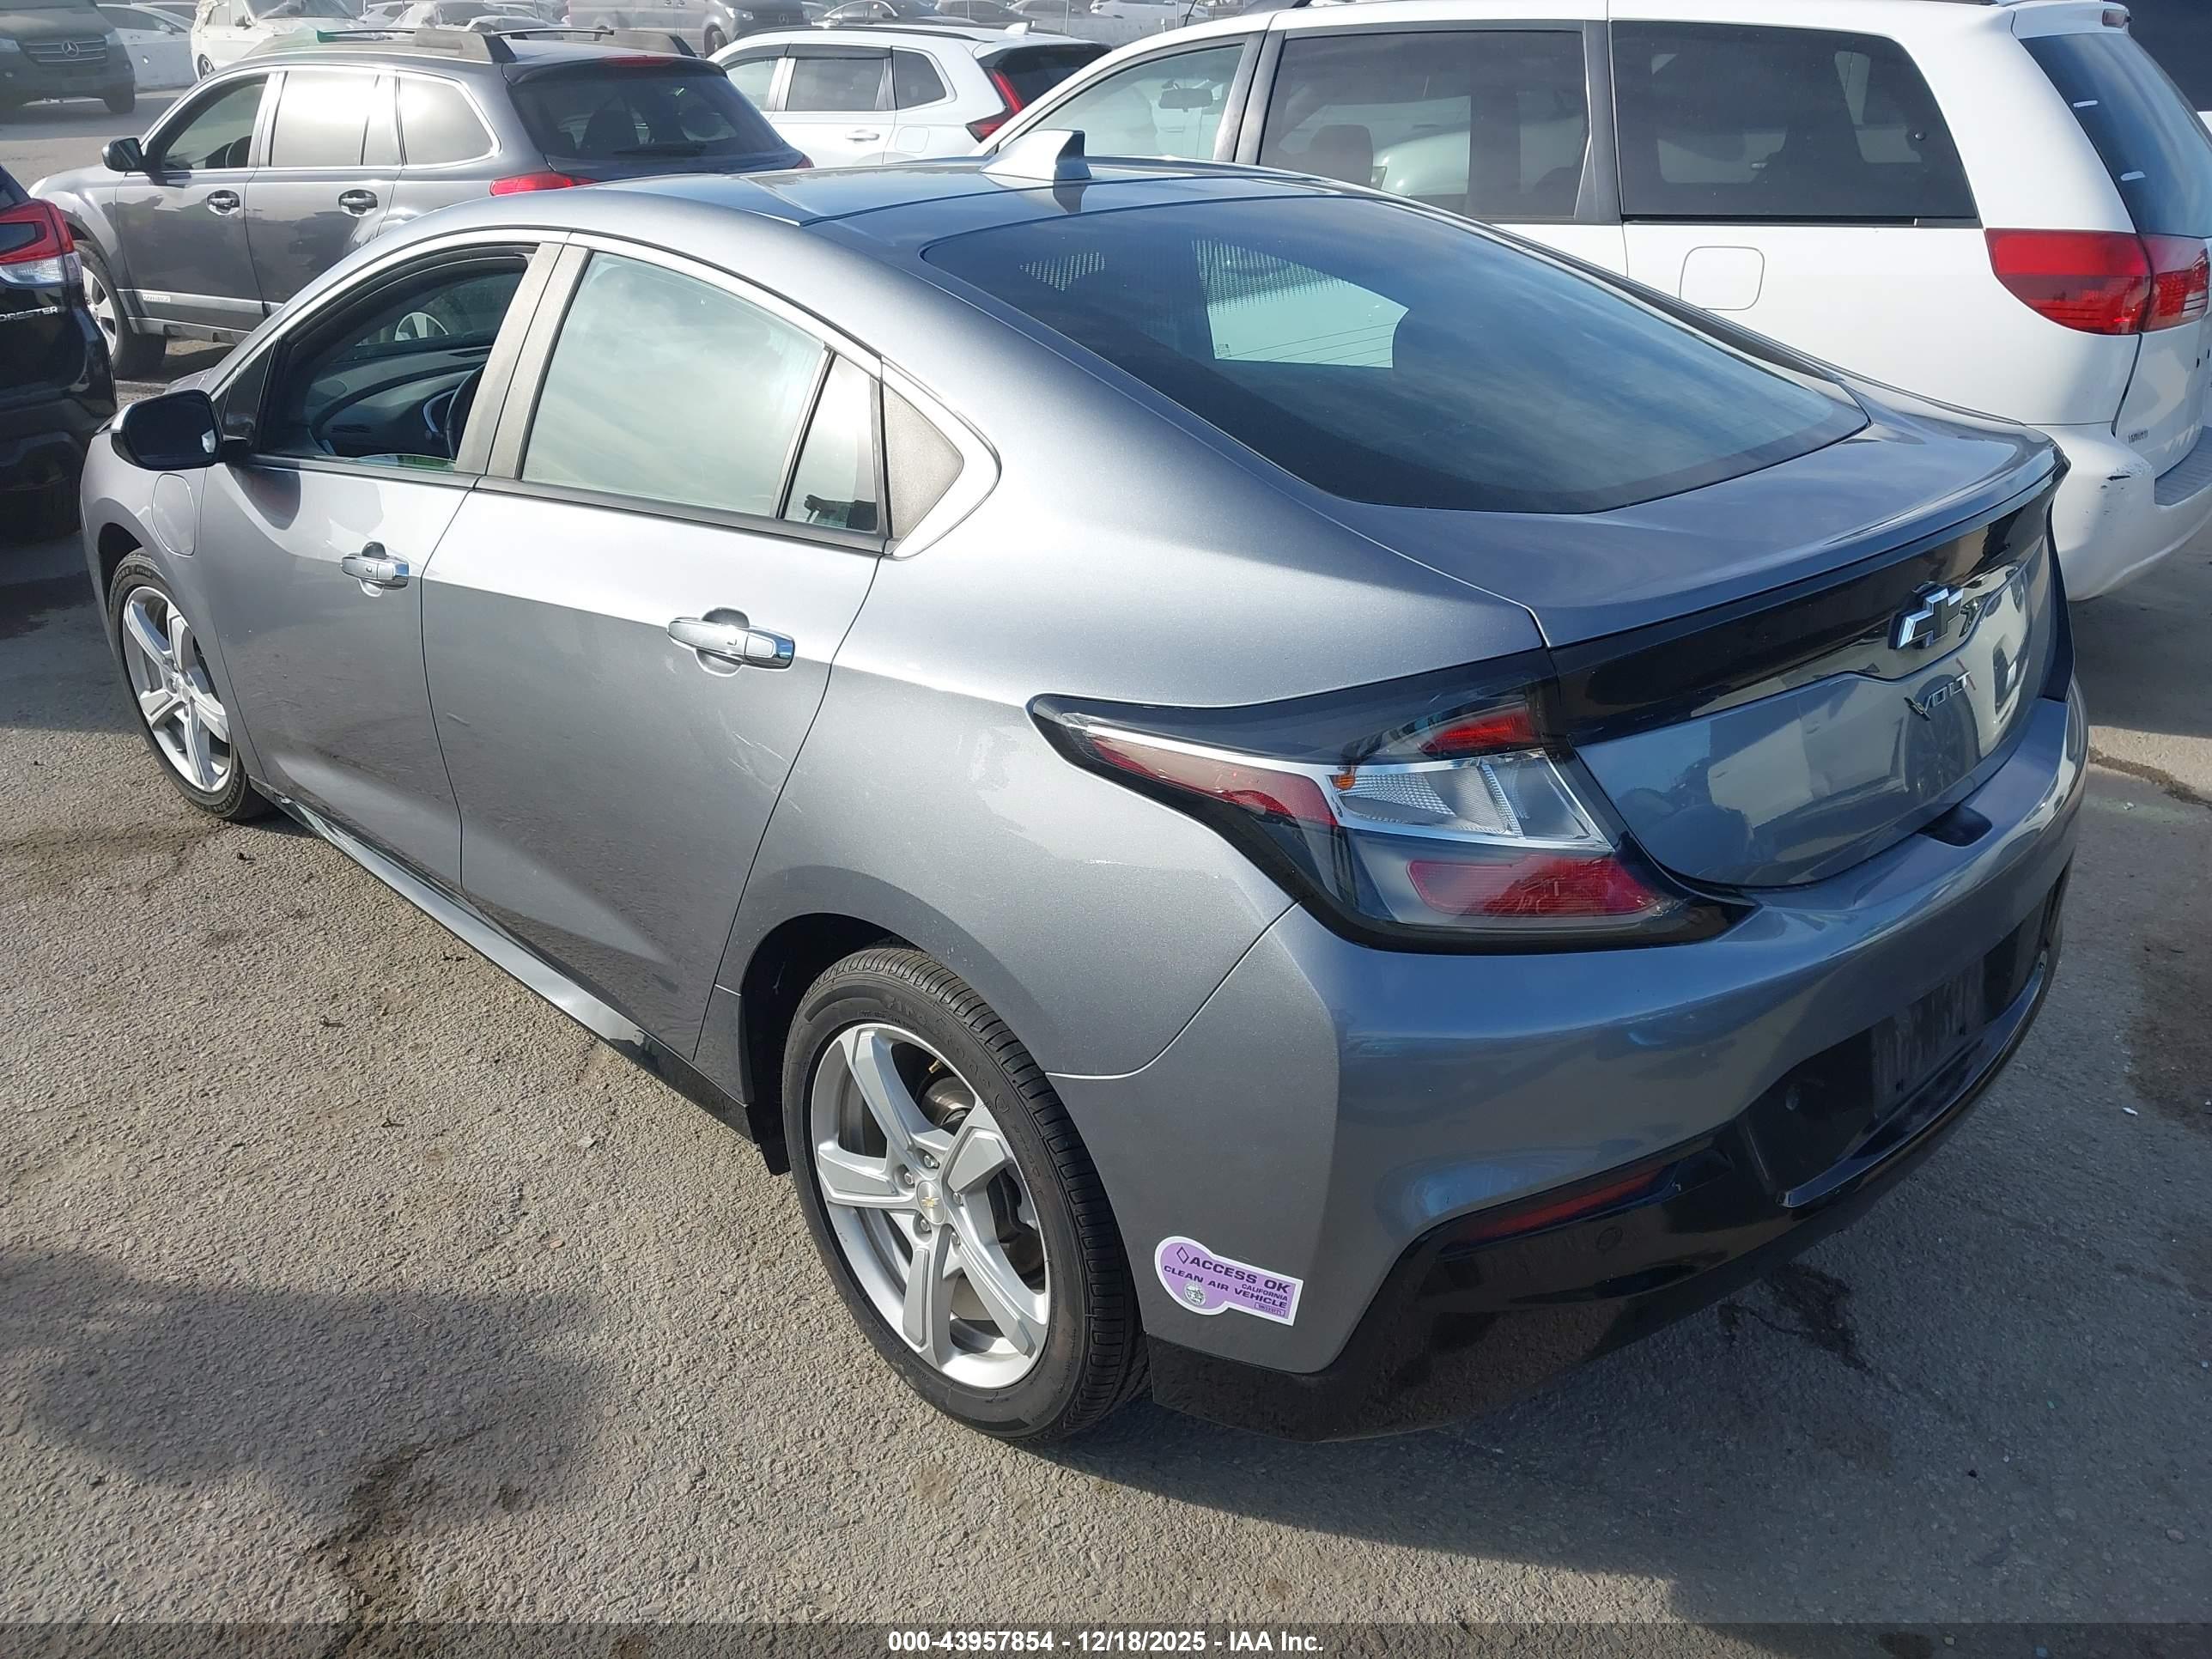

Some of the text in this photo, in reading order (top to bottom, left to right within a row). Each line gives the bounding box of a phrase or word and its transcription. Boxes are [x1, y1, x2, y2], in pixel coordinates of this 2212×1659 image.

[1904, 670, 1972, 721] VOLT
[1164, 1265, 1287, 1309] CLEAN AIR VEHICLE
[1189, 1256, 1291, 1294] ACCESS OK
[1242, 1284, 1288, 1301] CALIFORNIA
